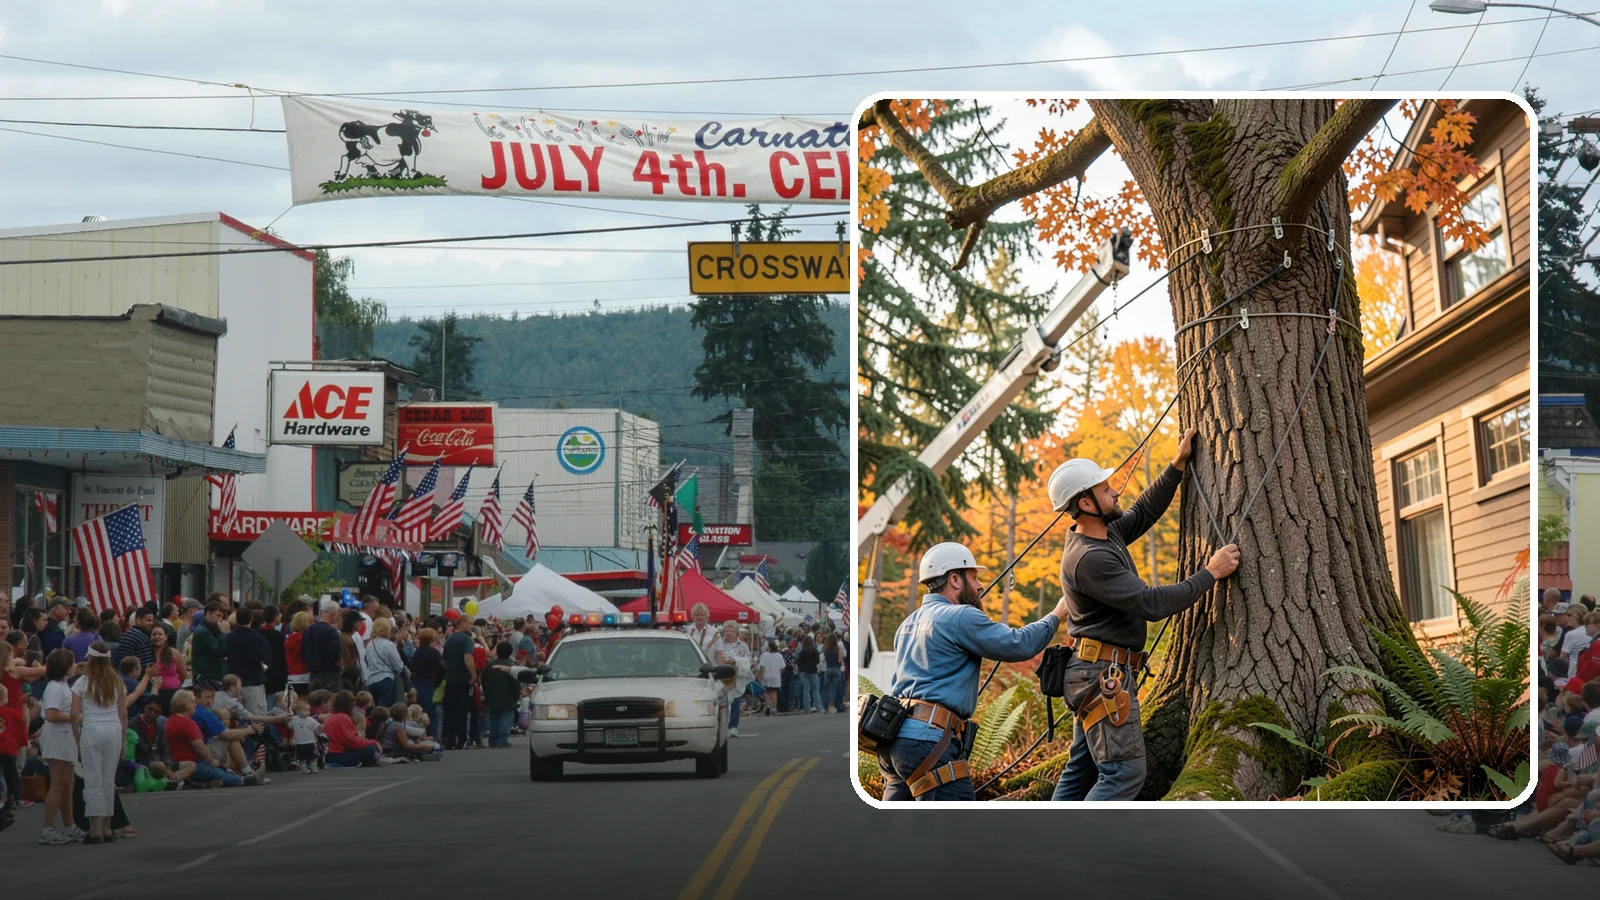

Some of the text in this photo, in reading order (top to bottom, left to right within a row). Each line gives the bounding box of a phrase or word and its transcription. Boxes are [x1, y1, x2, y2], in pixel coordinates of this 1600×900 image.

[481, 140, 605, 191] JULY
[632, 150, 746, 197] 4th.
[697, 254, 850, 280] CROSSWA
[283, 380, 373, 419] ACE
[405, 409, 453, 422] CEDAR
[283, 421, 371, 436] Hardware
[416, 428, 477, 447] Coca-Cola
[353, 467, 388, 480] Simpl
[95, 485, 124, 495] Vincent
[126, 486, 135, 495] de
[137, 486, 155, 495] Paul
[212, 515, 330, 535] HARDARE
[688, 526, 741, 535] CRNATION
[699, 535, 730, 543] GLASS
